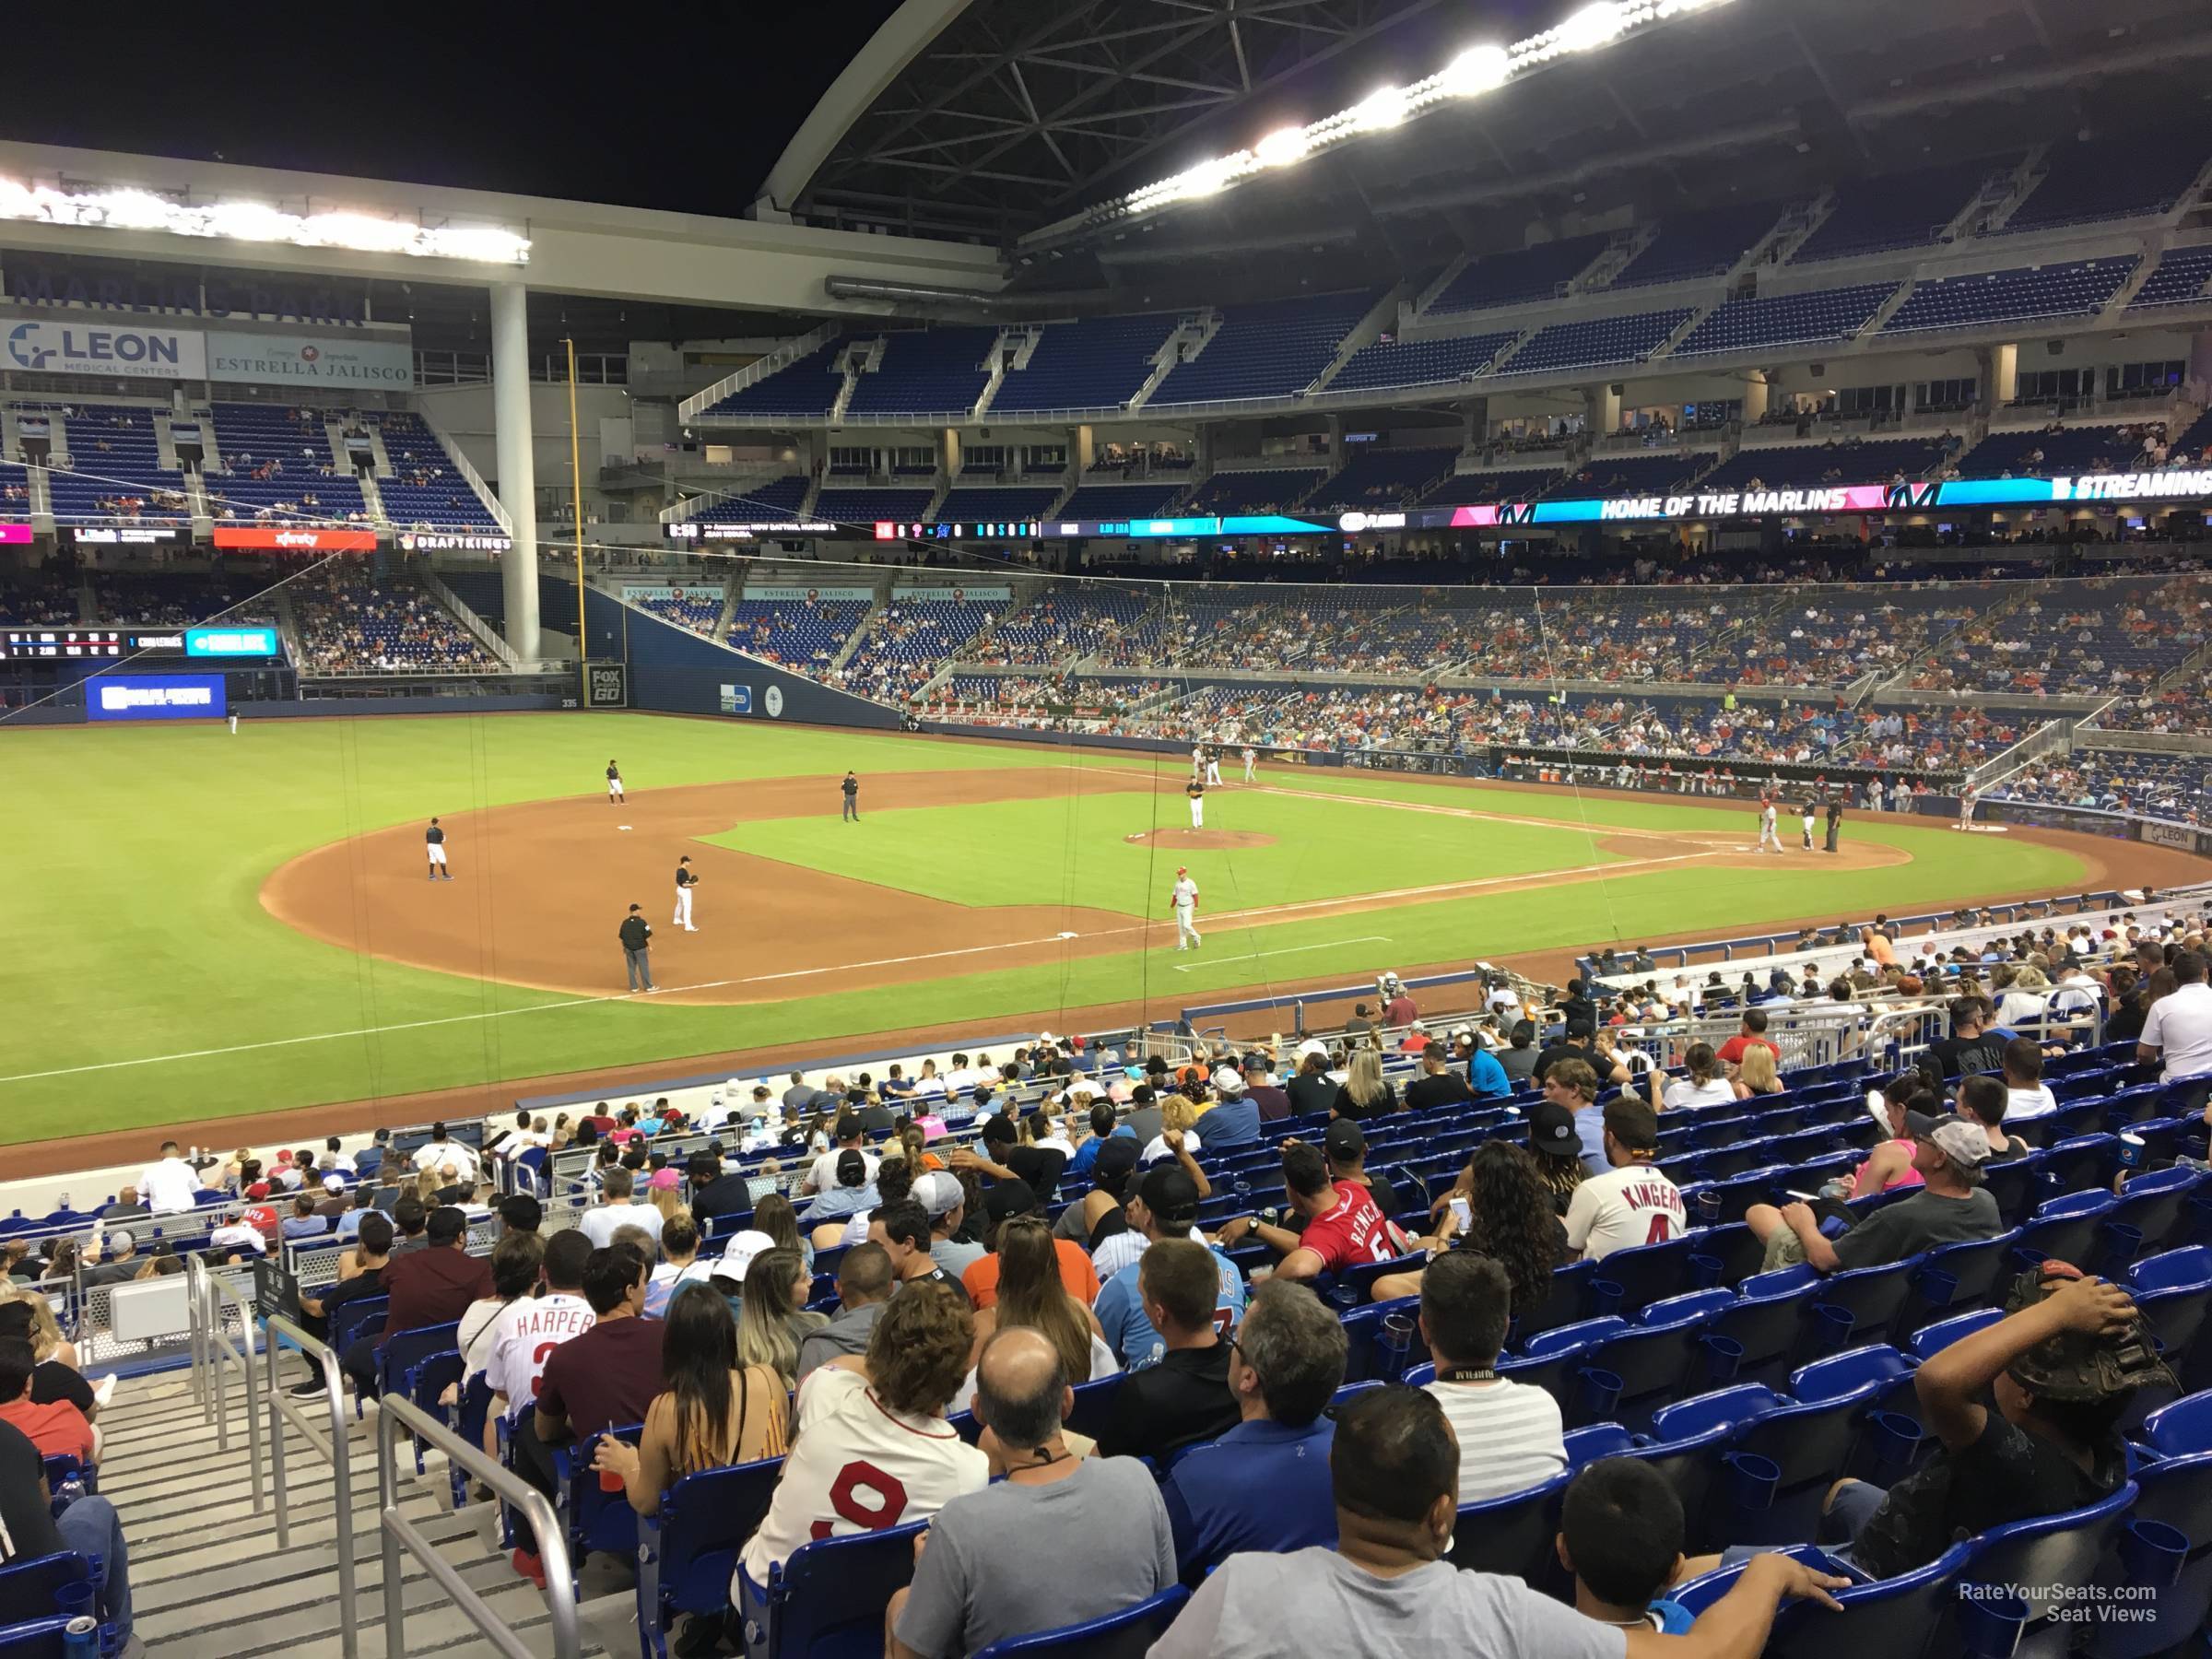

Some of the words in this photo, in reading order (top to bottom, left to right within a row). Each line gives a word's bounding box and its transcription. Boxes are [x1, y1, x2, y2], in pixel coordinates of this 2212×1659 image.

[14, 271, 231, 319] MARLINS
[251, 287, 364, 327] PARK
[63, 331, 178, 363] LEON
[65, 362, 120, 374] MEDICAL
[124, 364, 179, 377] CENTERS
[216, 357, 318, 376] ESTRELLA
[326, 364, 407, 382] JALISCO
[2075, 470, 2212, 500] STREAMING
[1601, 497, 1660, 520] HOME
[1665, 495, 1692, 516] OF
[1696, 492, 1737, 514] THE
[1742, 488, 1848, 512] MARLINS
[417, 535, 512, 550] DRAFTKINGS
[627, 589, 670, 597] ESTRELLA
[593, 670, 620, 683] FOX
[562, 699, 577, 708] 335
[594, 688, 620, 700] GO
[2162, 830, 2188, 843] LEON
[1350, 1200, 1381, 1248] BENCH
[1370, 1231, 1392, 1262] 5
[517, 1311, 594, 1338] HARPER
